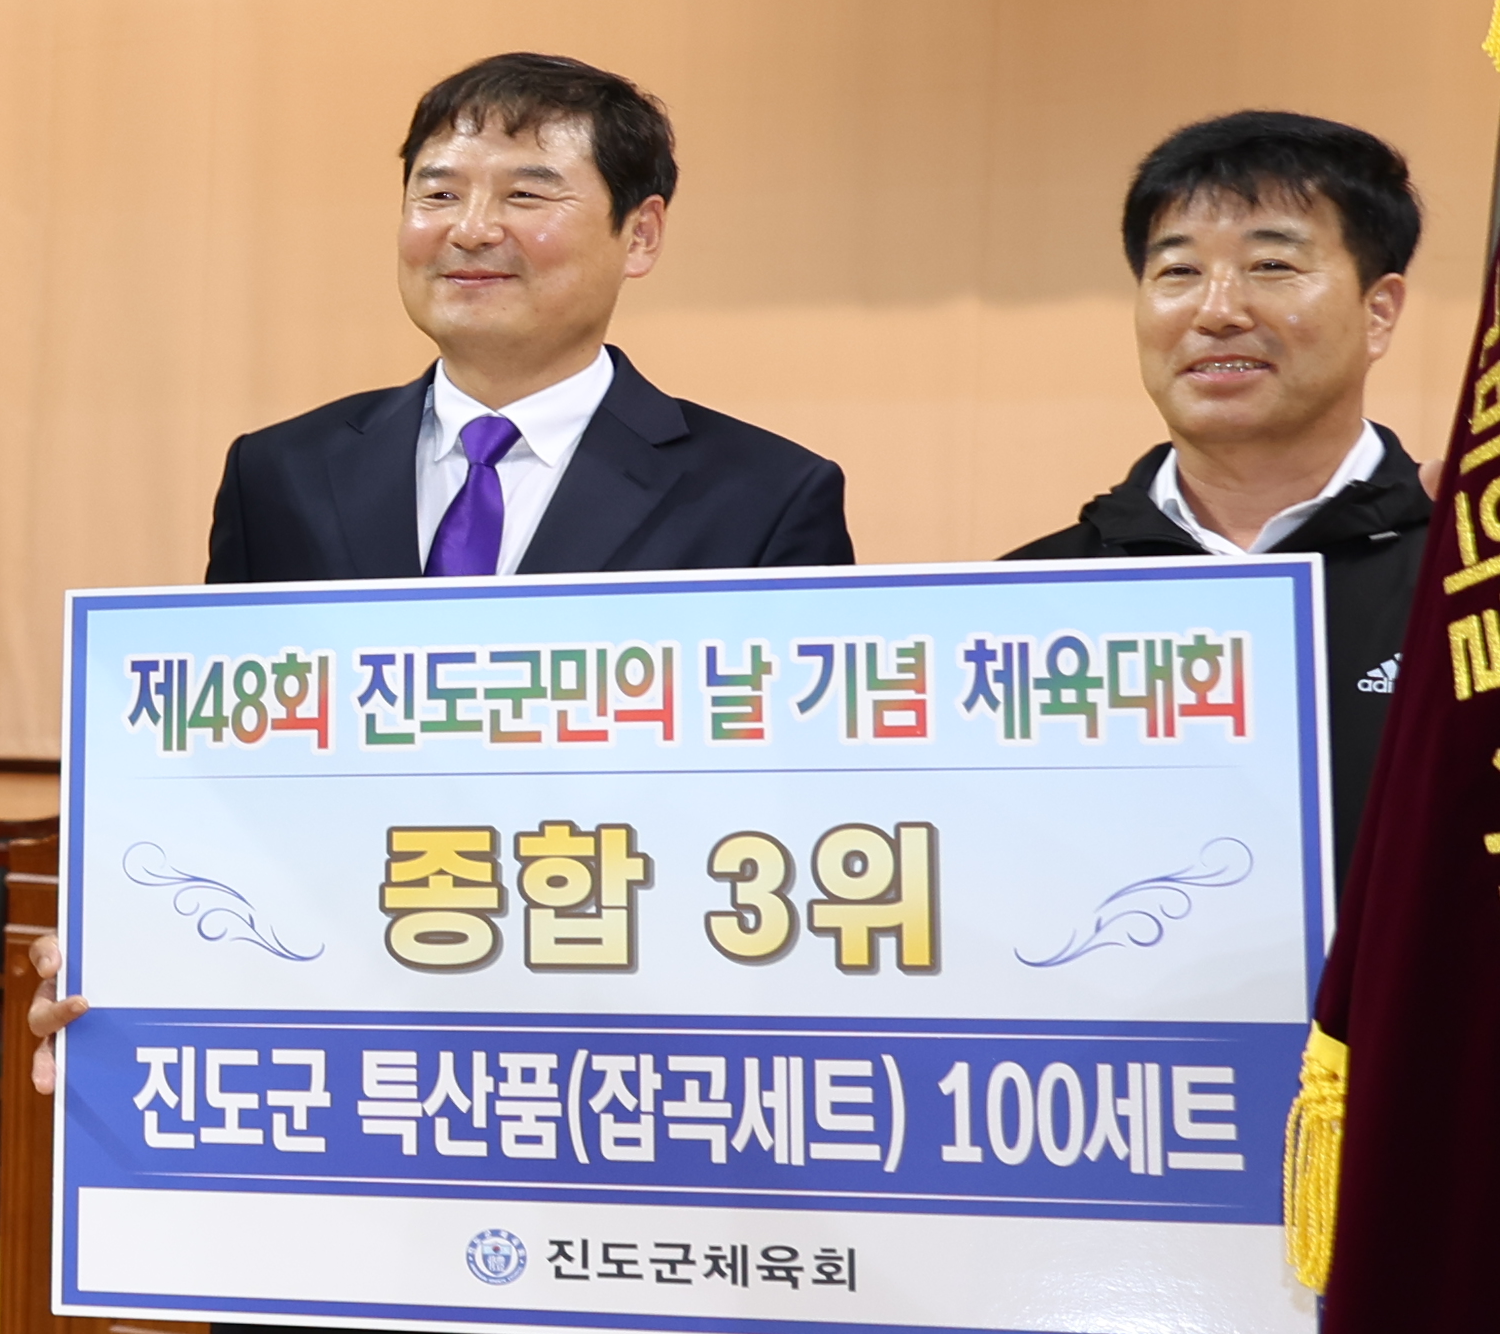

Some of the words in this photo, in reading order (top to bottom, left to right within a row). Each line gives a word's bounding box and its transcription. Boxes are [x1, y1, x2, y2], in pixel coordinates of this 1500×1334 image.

[127, 652, 330, 752] 제48회
[357, 645, 675, 746] 진도군민의
[705, 644, 772, 741] 날
[796, 640, 929, 739] 기념
[961, 633, 1247, 740] 체육대회
[379, 820, 654, 973] 종합
[704, 821, 942, 975] 3위
[132, 1045, 332, 1153] 진도군
[357, 1048, 906, 1173] 특산품(잡곡세트)
[937, 1060, 1246, 1176] 100세트
[545, 1237, 857, 1292] 진도군체육회
